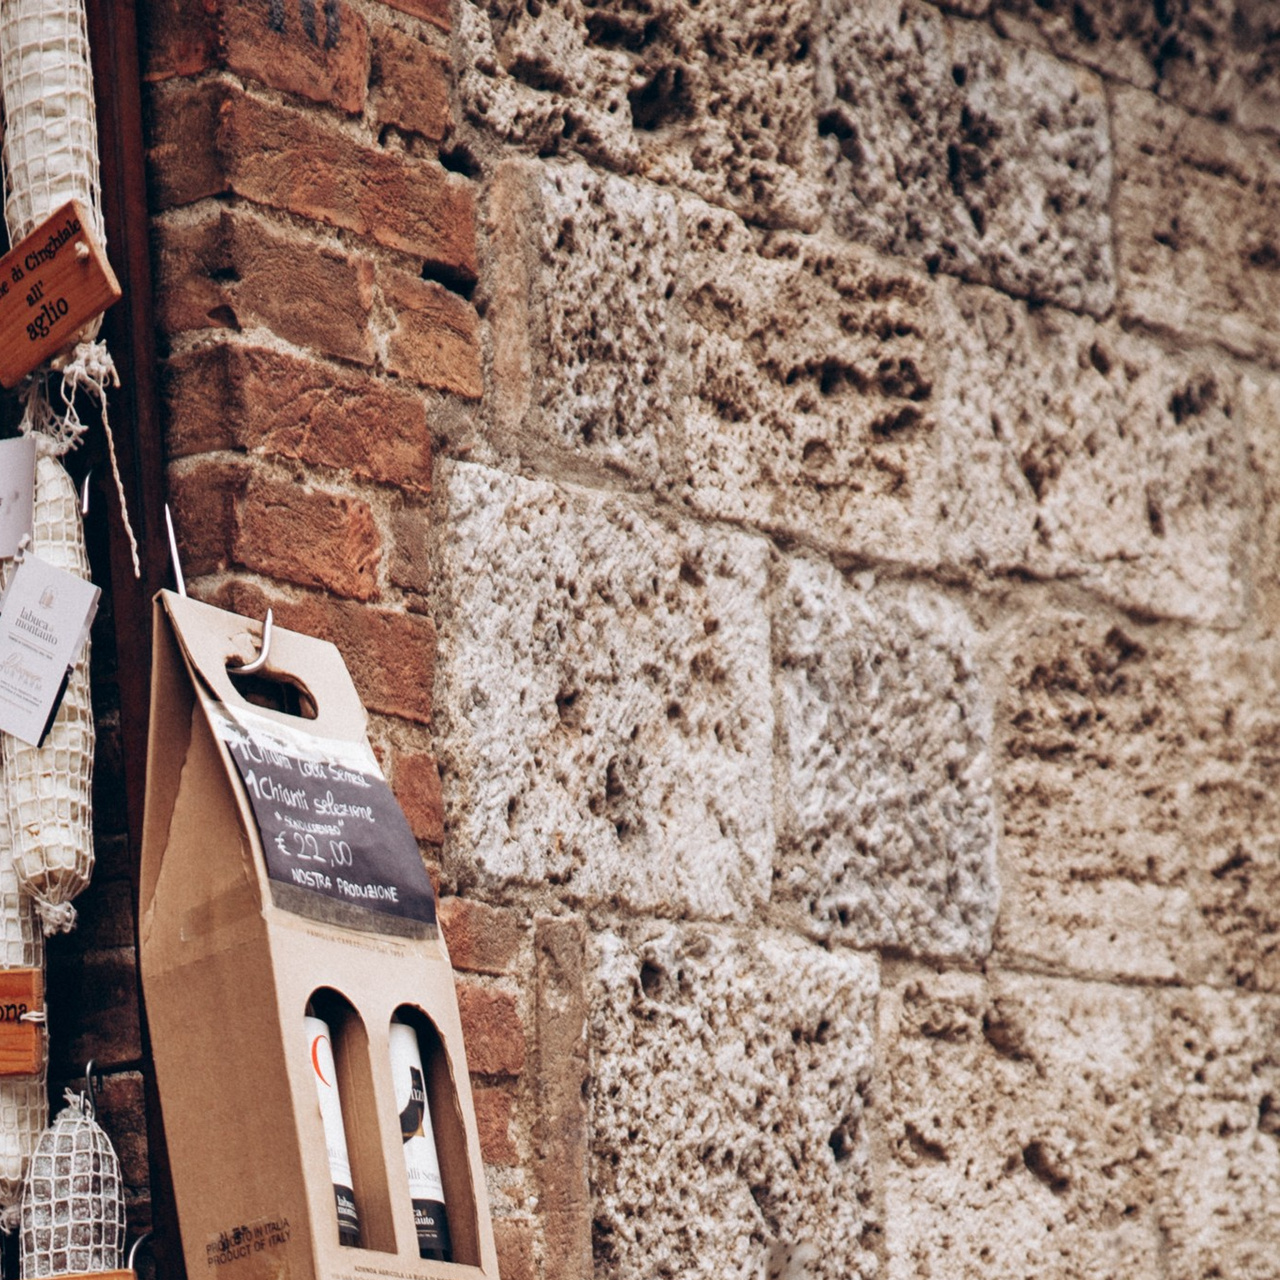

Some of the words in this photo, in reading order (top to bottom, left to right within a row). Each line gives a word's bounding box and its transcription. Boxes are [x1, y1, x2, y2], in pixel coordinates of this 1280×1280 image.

[11, 264, 25, 283] di
[25, 217, 81, 273] Cinghiale
[25, 295, 70, 342] aglio
[294, 833, 353, 868] 22,00
[291, 868, 332, 889] NOSTRA
[338, 878, 399, 902] PRODUZIONE
